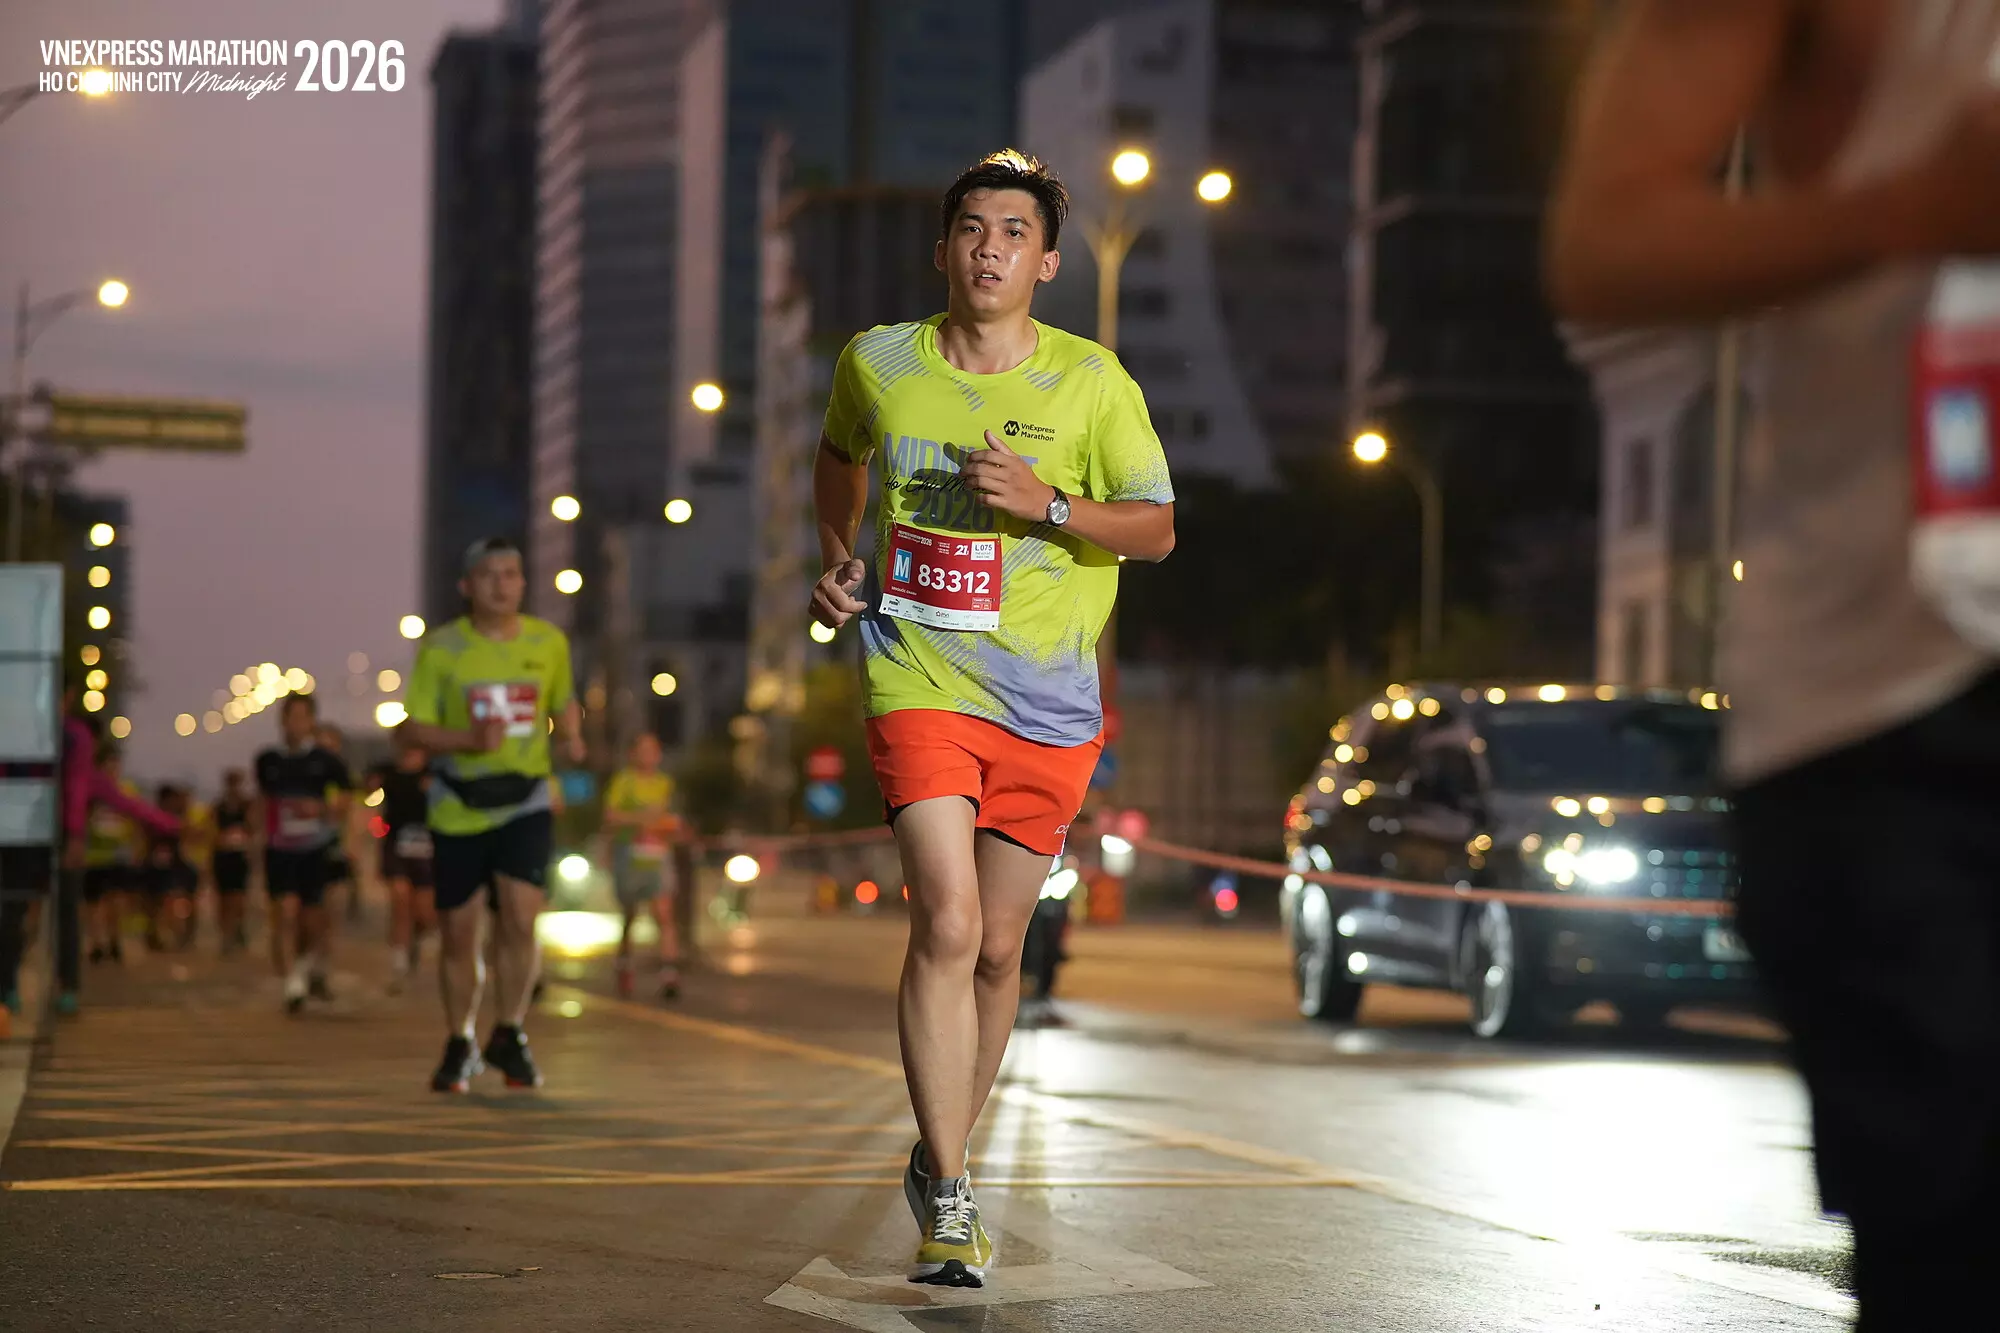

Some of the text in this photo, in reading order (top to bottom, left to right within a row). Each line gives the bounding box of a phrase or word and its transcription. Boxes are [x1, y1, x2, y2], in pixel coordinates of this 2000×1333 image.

[1020, 431, 1054, 442] Marathon
[1021, 422, 1056, 434] VnExpress
[894, 554, 910, 579] M
[917, 563, 991, 595] 83312
